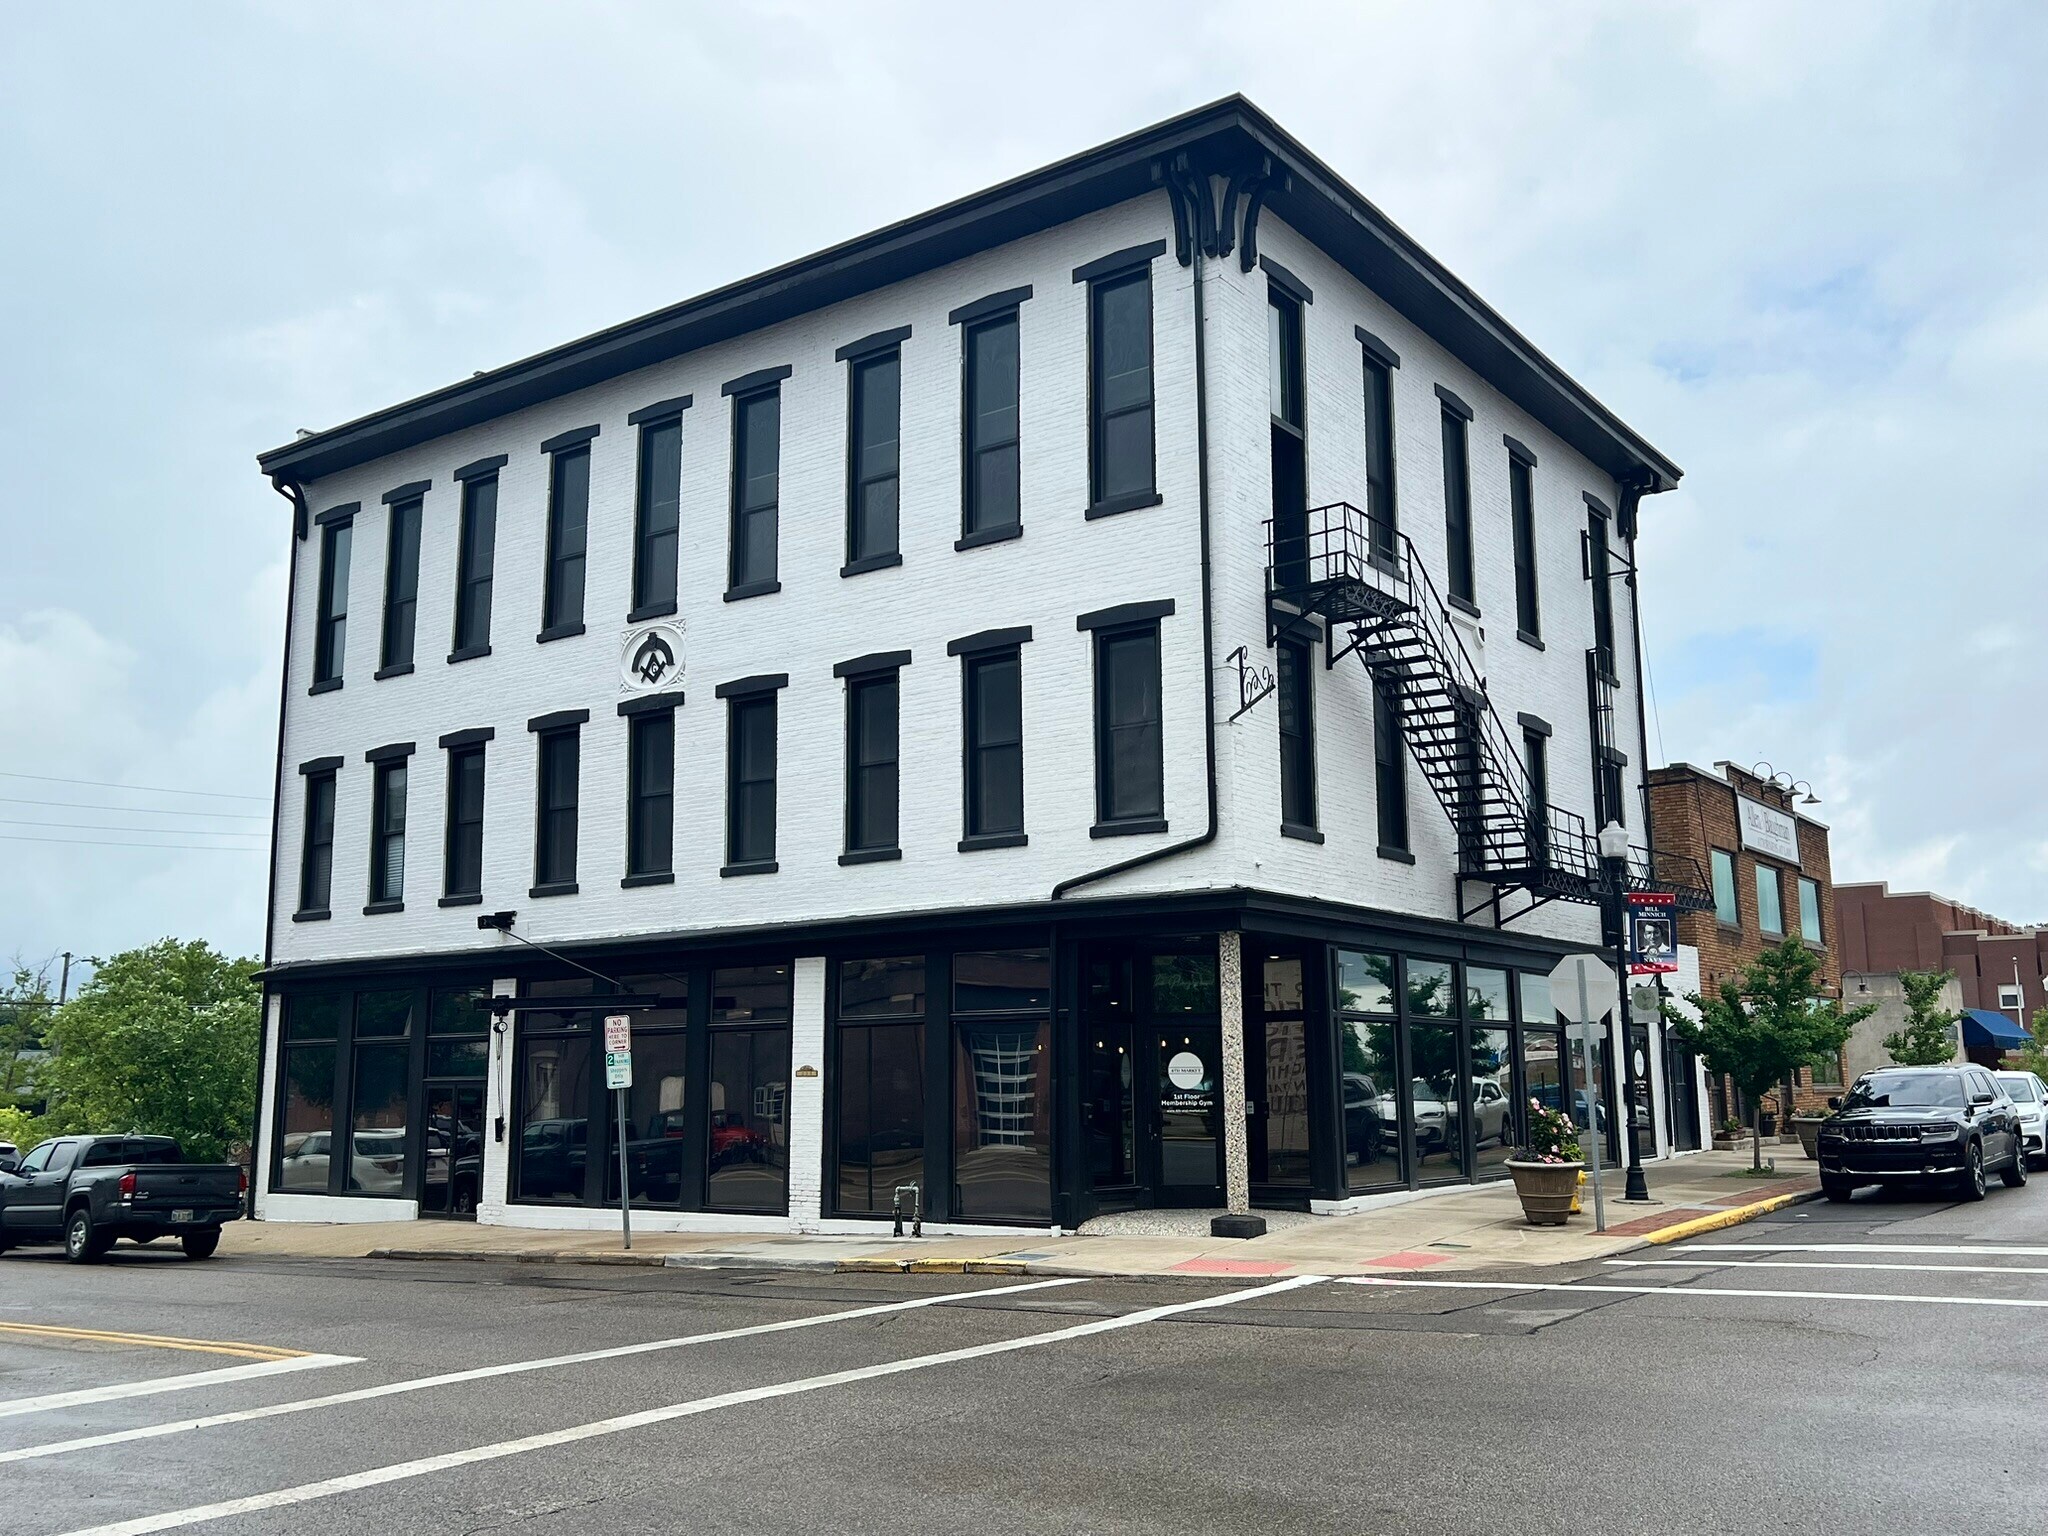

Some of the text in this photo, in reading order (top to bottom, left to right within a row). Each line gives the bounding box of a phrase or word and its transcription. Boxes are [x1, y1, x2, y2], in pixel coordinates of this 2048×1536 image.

[651, 661, 660, 674] G
[612, 1019, 622, 1027] NO
[607, 1055, 615, 1065] 2
[1161, 1099, 1213, 1107] Membership Gym
